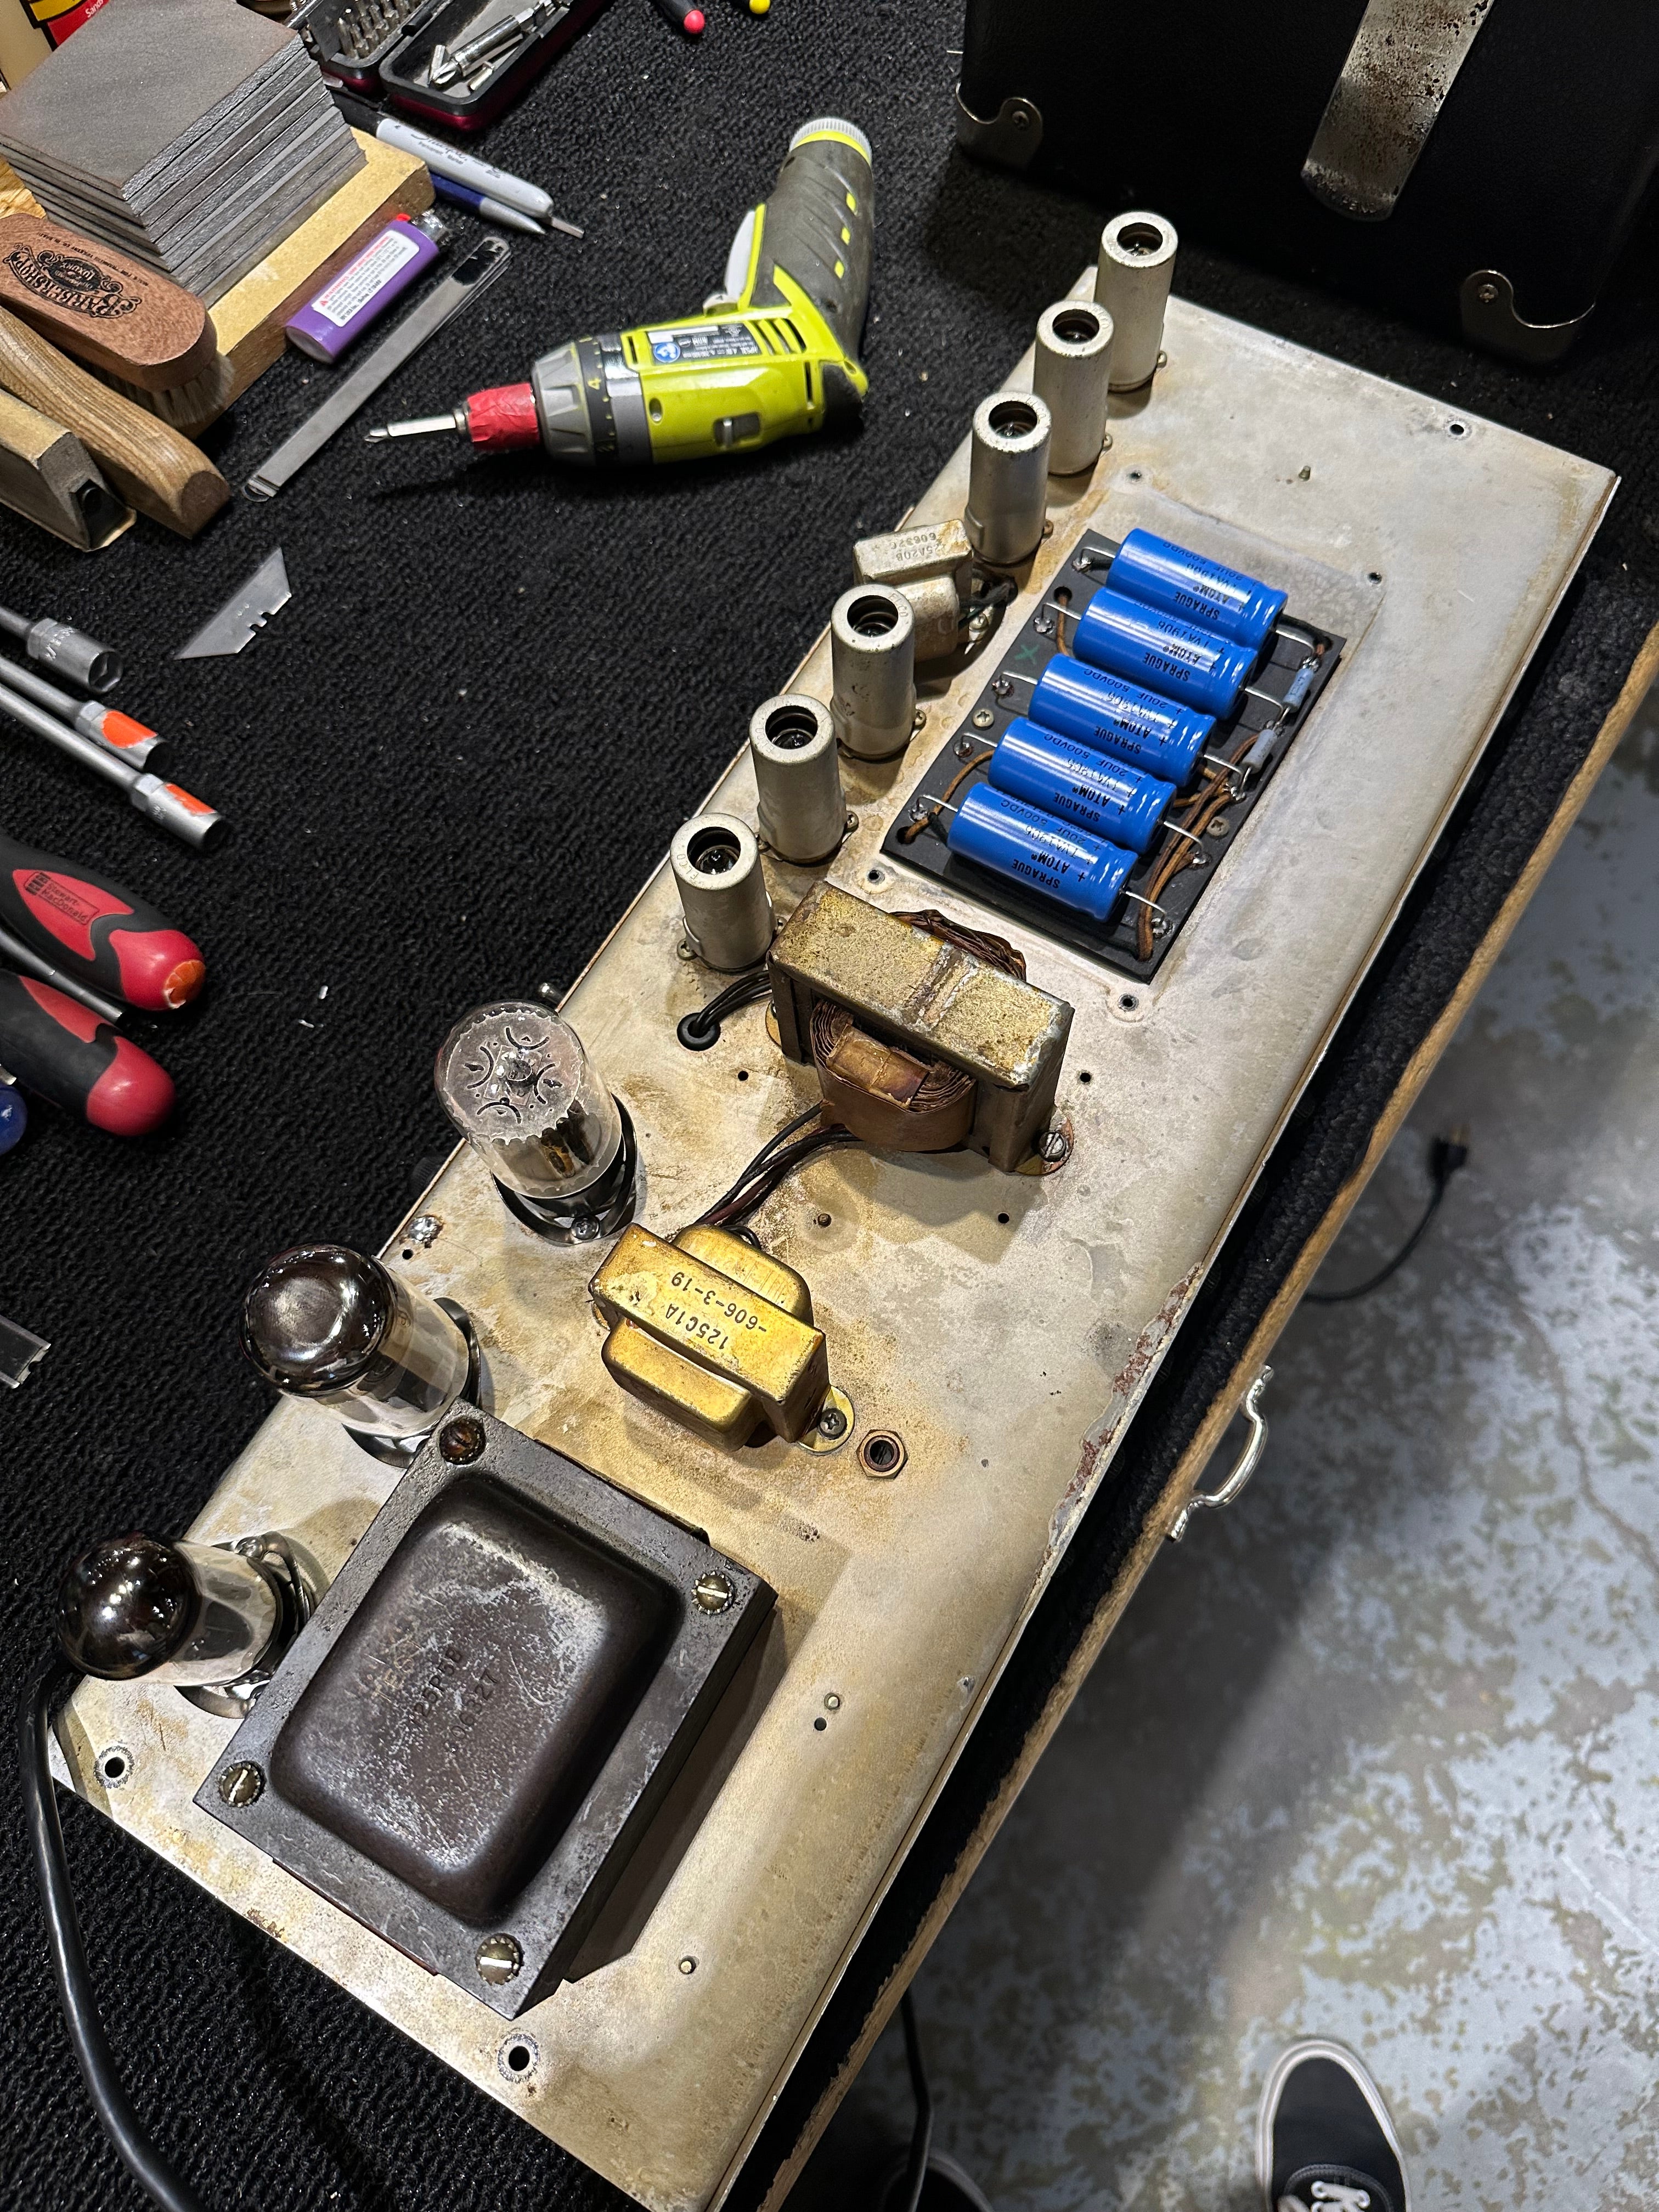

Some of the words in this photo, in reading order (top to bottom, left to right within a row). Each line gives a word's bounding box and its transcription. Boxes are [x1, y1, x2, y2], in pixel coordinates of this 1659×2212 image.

[586, 376, 603, 392] 4
[1172, 591, 1220, 620] SPRAGUE
[1156, 619, 1210, 648] TVA1906
[1082, 667, 1131, 693] 500VDC
[1142, 652, 1191, 682] SPRAGUE
[1136, 690, 1168, 710] 20UF
[1042, 732, 1091, 760] 500VDC
[1092, 725, 1142, 755] SPRAGUE
[1095, 758, 1128, 777] 20UF
[999, 798, 1048, 826] 500VDC
[1051, 792, 1101, 822] SPRAGUE
[1023, 825, 1078, 859] TVA1906
[1053, 826, 1086, 845] 20UF
[1010, 858, 1060, 889] SPRAGUE
[669, 1269, 770, 1338] -606-3-19
[662, 1302, 730, 1351] 125C1A
